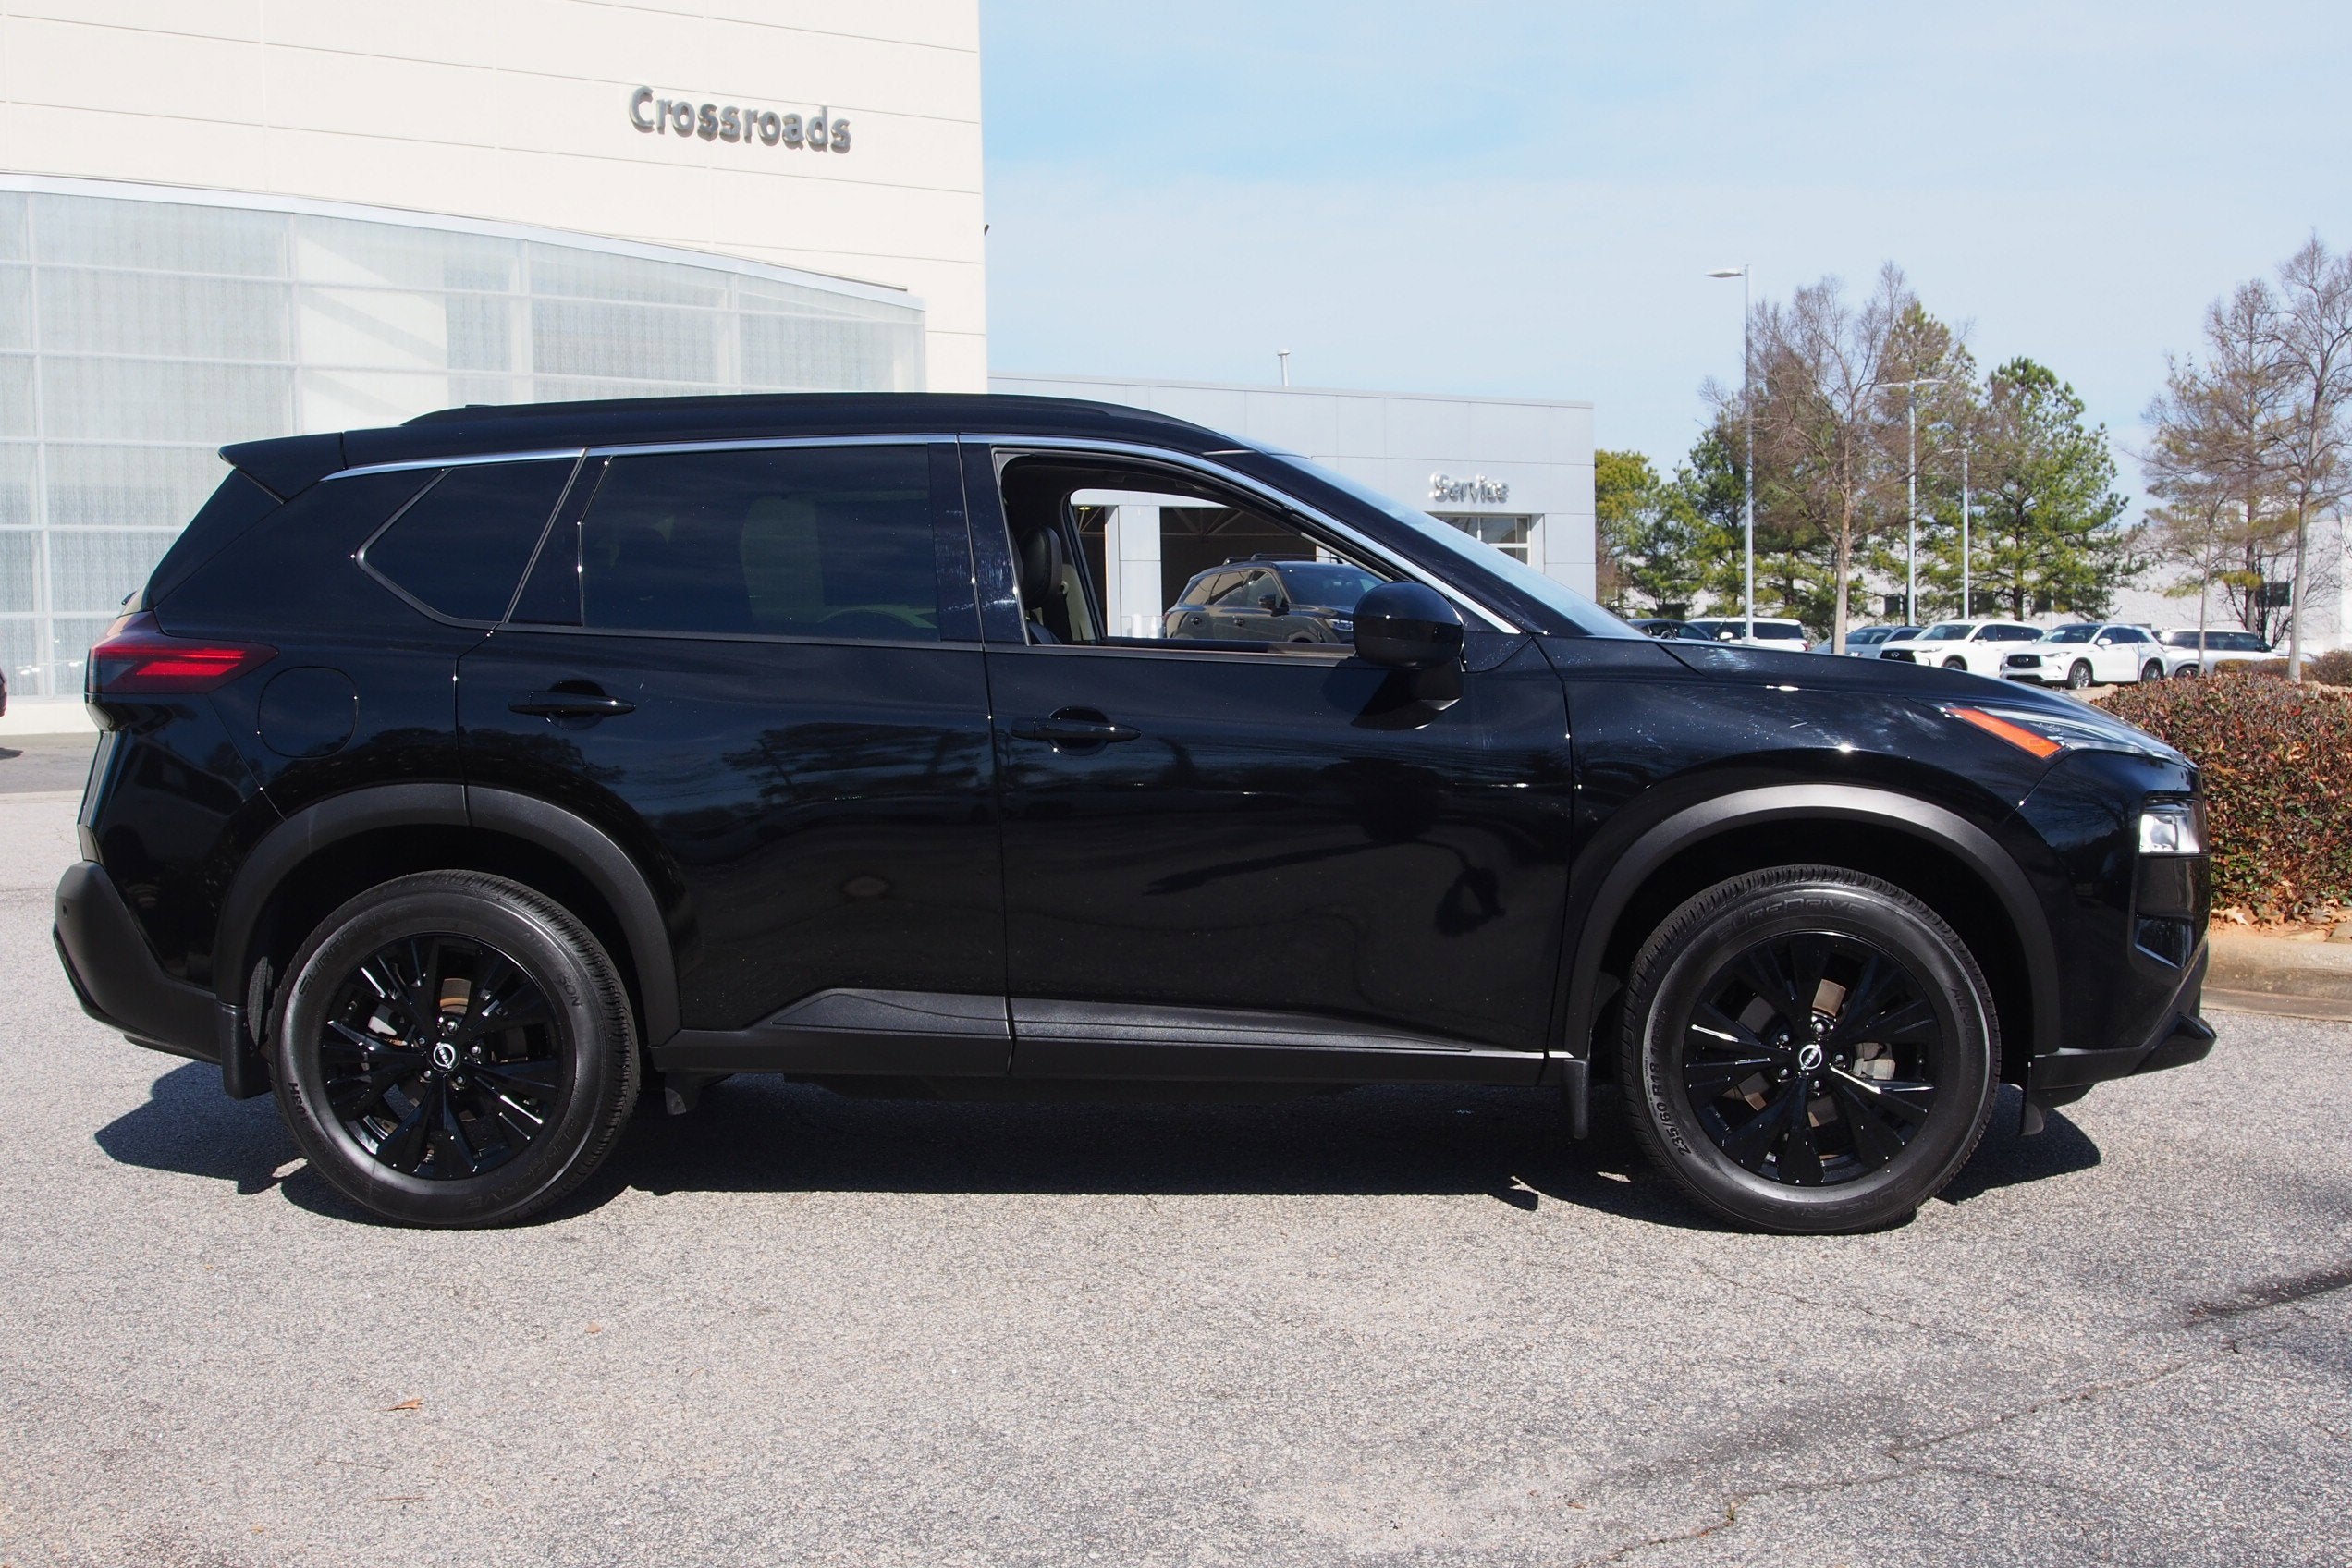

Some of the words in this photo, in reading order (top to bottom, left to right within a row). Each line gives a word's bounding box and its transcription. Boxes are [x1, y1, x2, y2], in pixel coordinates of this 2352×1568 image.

[629, 85, 851, 153] Crossroads
[1429, 472, 1510, 504] Service
[1649, 1062, 1663, 1097] R18
[1656, 1102, 1692, 1157] 235/60
